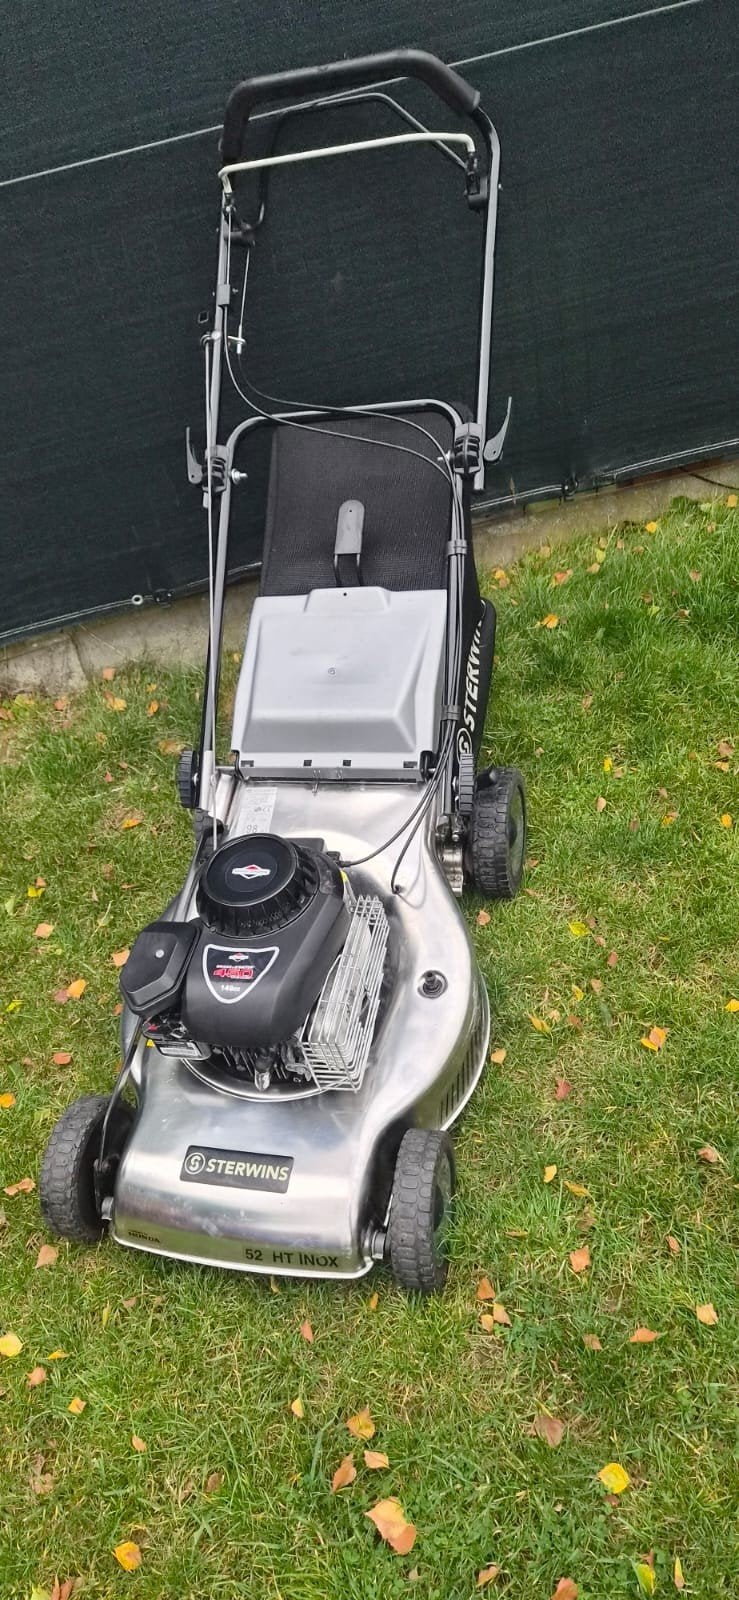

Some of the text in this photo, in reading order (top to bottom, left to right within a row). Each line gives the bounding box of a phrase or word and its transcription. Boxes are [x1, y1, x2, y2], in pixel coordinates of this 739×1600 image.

[205, 1158, 289, 1181] STERWINS
[245, 1248, 338, 1268] 52 HT INOX
